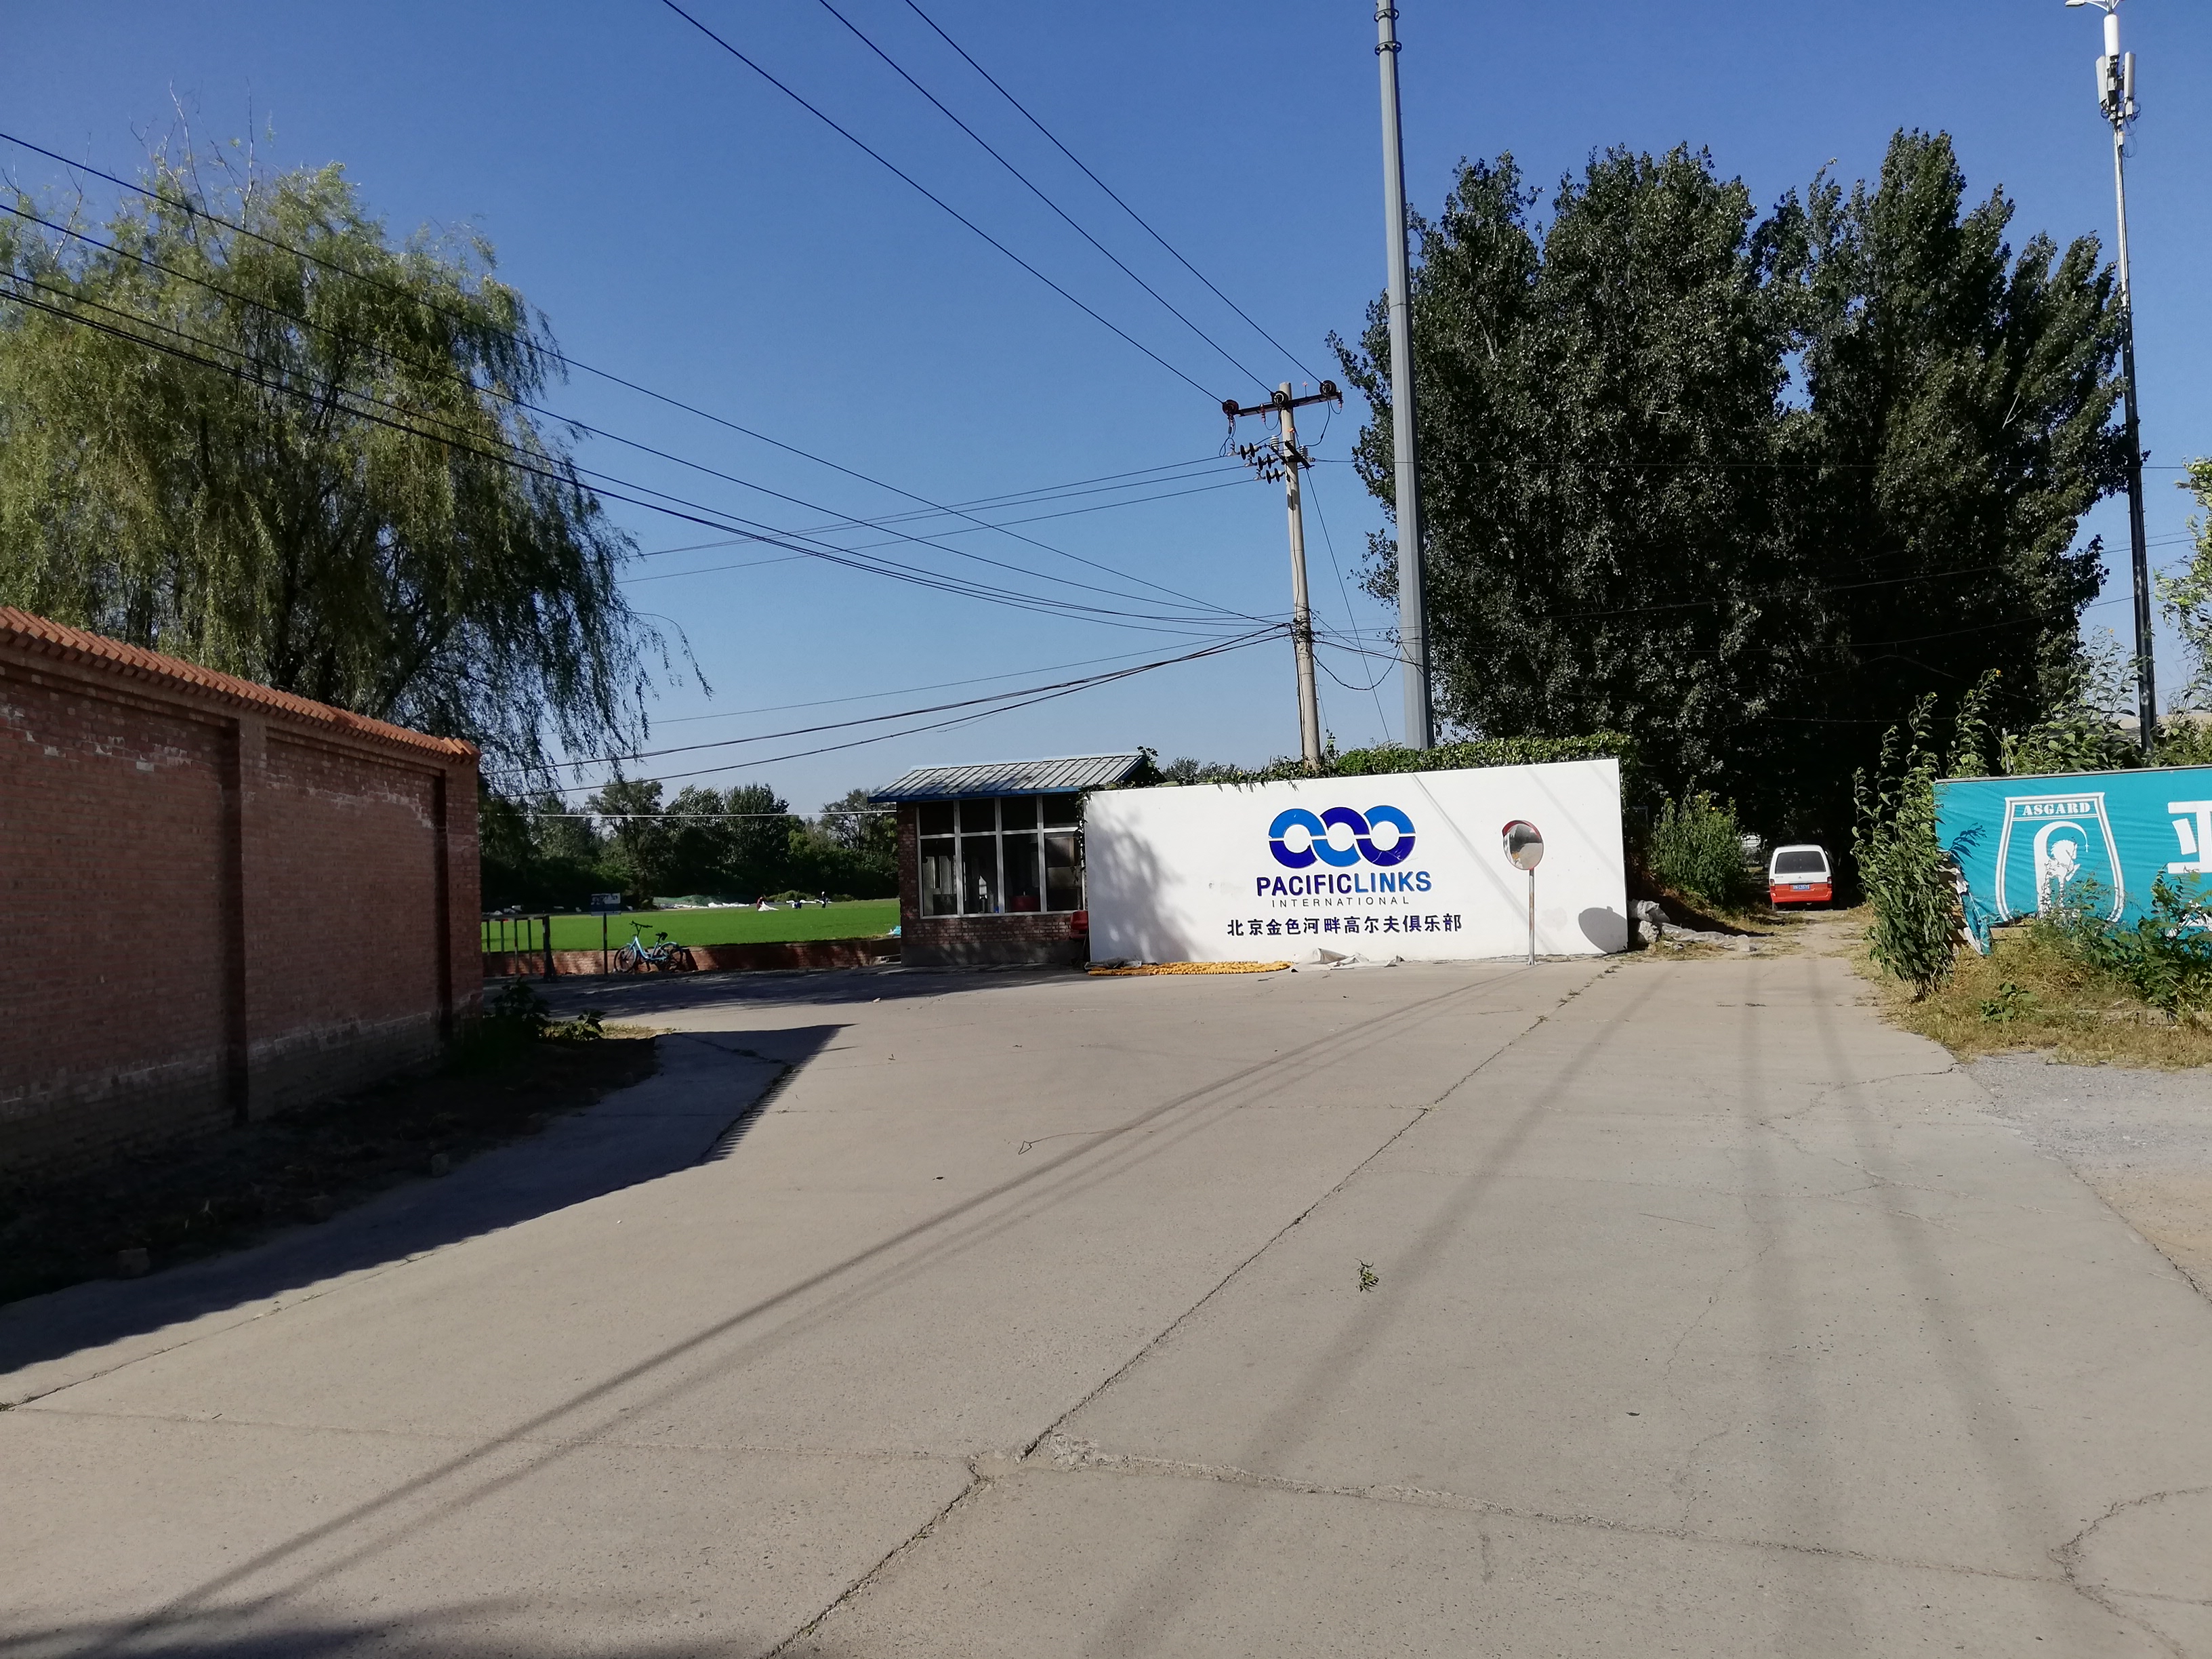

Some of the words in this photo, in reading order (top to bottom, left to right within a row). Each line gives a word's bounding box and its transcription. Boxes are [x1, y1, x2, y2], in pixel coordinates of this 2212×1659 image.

[2022, 802, 2091, 815] ASGARD
[1271, 897, 1410, 908] INTERNATIONAL
[1227, 913, 1462, 937] 北京金色河畔高尔夫俱乐部
